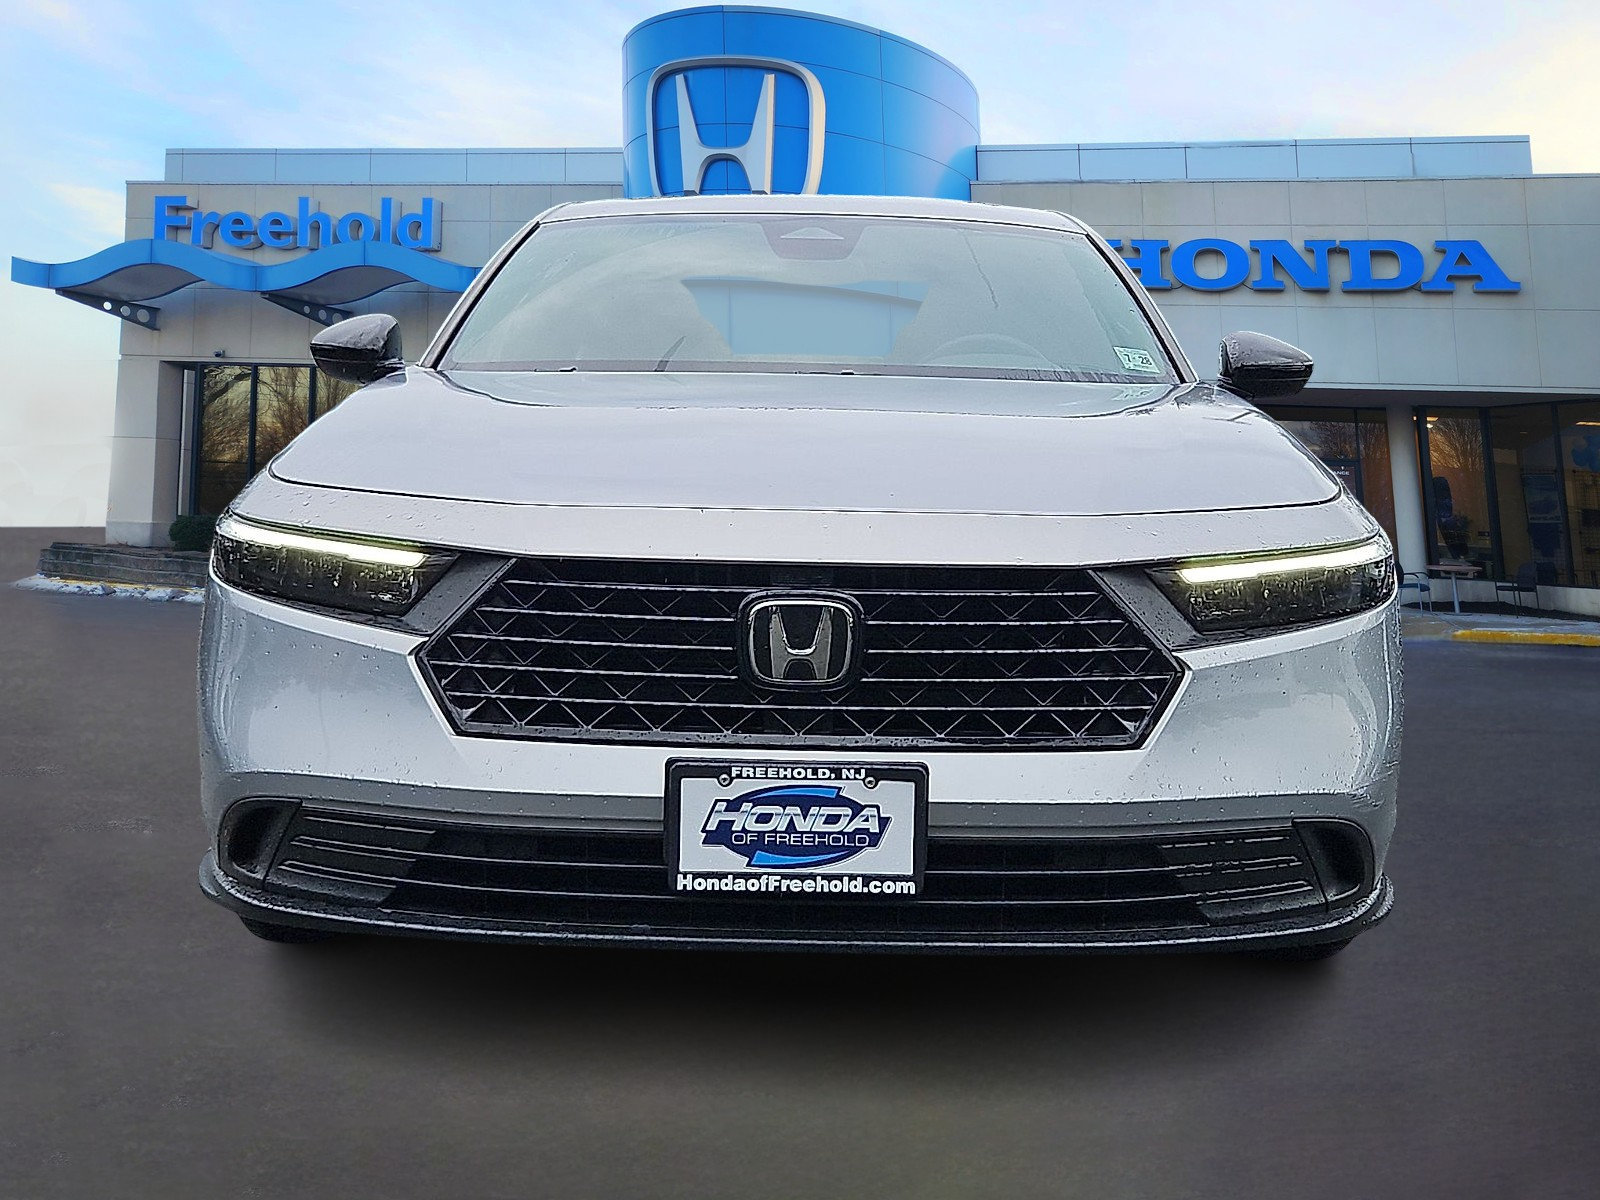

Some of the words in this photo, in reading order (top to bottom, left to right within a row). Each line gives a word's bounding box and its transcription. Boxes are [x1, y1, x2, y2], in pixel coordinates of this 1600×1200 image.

[154, 195, 441, 251] Freehold
[1106, 238, 1521, 293] HONDA
[842, 768, 866, 780] NJ
[705, 801, 880, 833] HONDA
[732, 833, 757, 845] OF
[764, 833, 870, 847] FREEHOLD
[676, 874, 916, 895] HondaofFreehold.com
